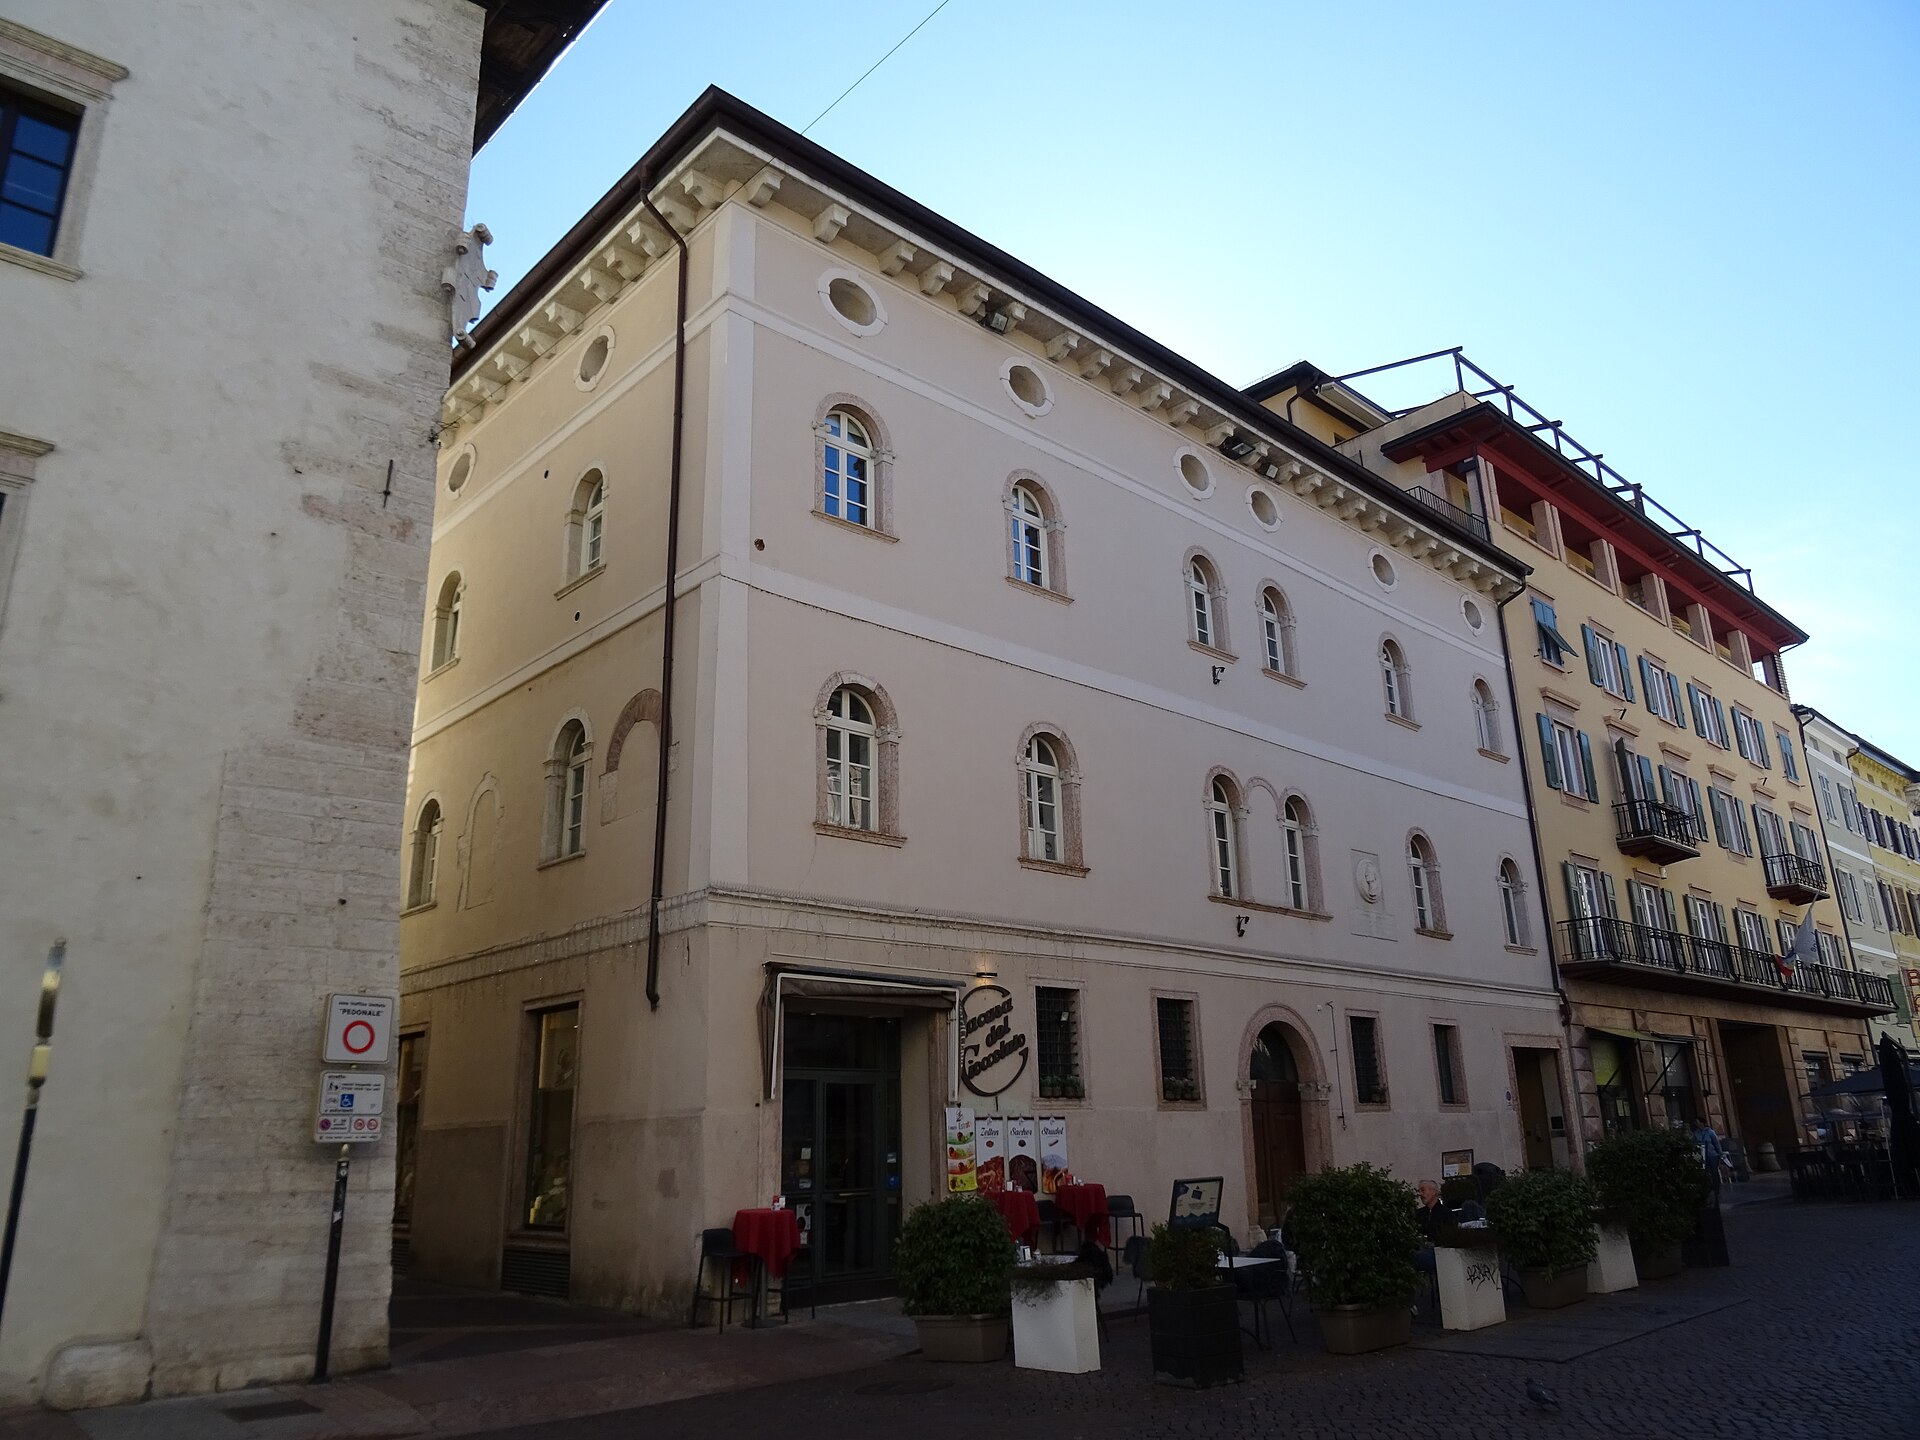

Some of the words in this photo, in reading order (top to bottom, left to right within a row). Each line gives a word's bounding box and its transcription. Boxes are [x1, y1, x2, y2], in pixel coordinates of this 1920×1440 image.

[986, 1015, 1011, 1047] del
[980, 1127, 999, 1137] Zelten
[1010, 1127, 1033, 1136] Sacher
[1041, 1127, 1064, 1136] Strudel
